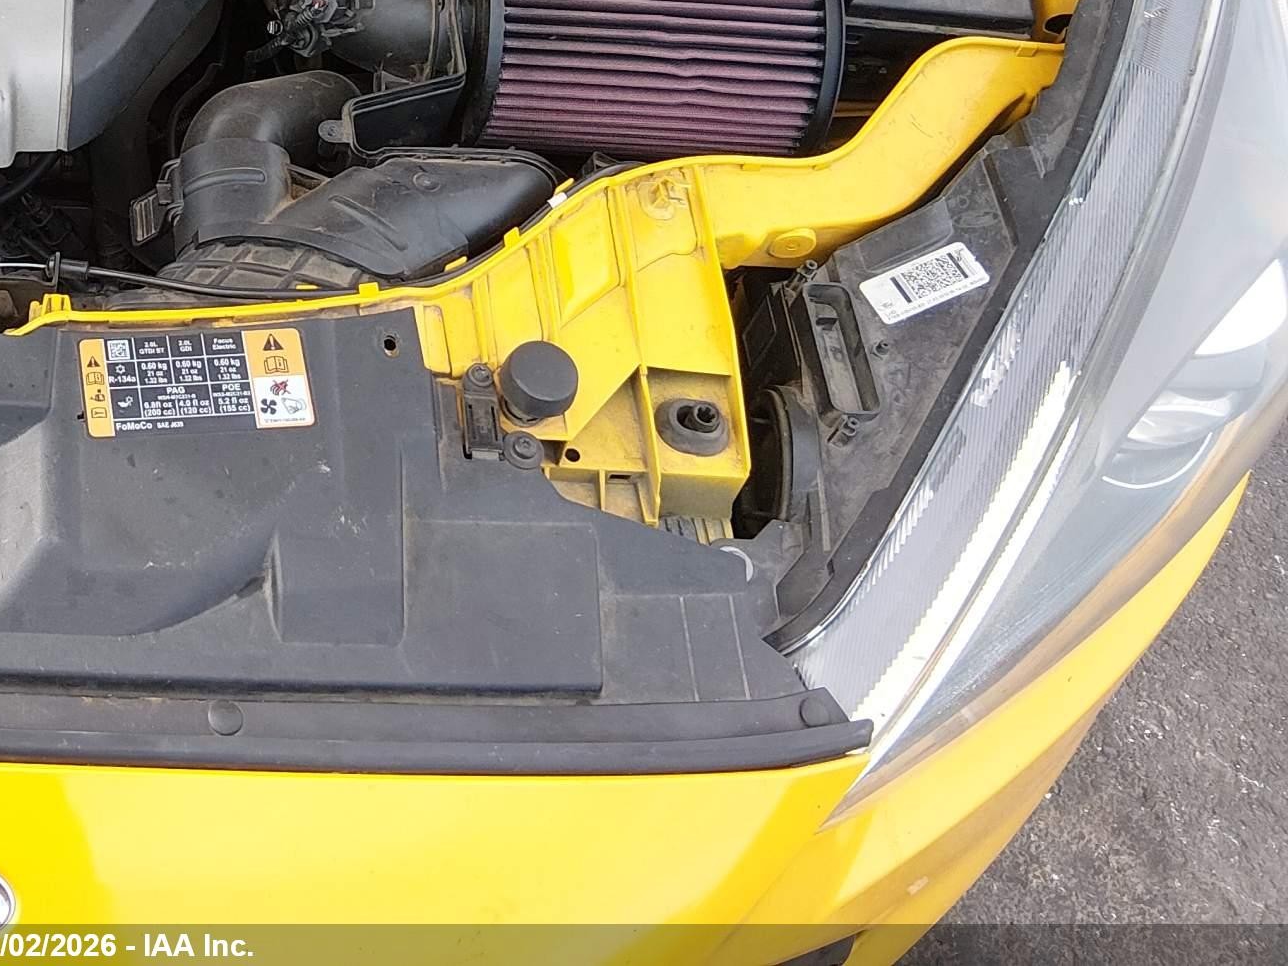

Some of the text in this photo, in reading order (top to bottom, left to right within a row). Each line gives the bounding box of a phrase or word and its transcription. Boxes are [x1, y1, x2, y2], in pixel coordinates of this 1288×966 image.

[141, 361, 168, 371] 0.60 kg
[214, 358, 241, 367] 0.60 kg
[108, 375, 136, 384] R-134a
[166, 386, 185, 394] PAG
[222, 383, 241, 391] POE
[144, 408, 176, 417] (200 cc)
[180, 406, 212, 415] (120 cc)
[219, 404, 251, 413] (155 cc)
[115, 421, 153, 431] FoMoCo
